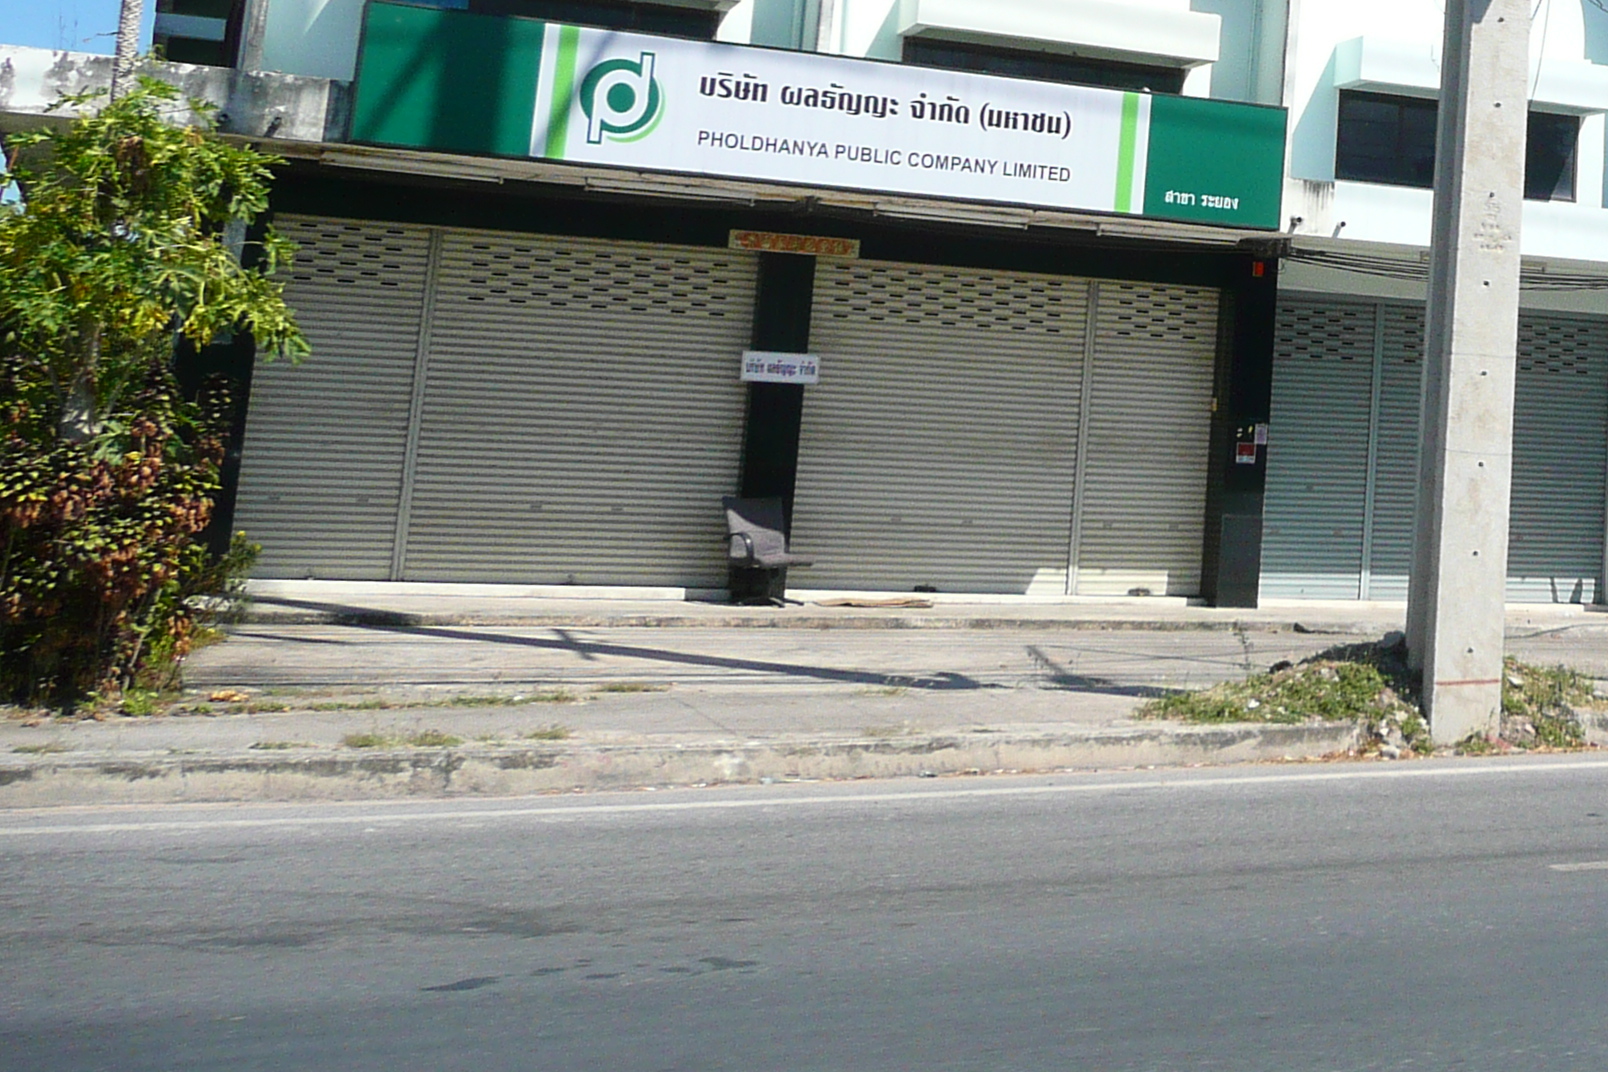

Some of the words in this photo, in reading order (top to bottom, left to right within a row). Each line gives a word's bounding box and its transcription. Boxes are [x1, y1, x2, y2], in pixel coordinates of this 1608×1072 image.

[699, 72, 768, 102] บริษัท
[781, 83, 899, 118] ผลธัญญะ
[910, 93, 970, 124] จำกัด
[980, 102, 1071, 140] (มหาชน)
[698, 130, 829, 158] PHOLDHANYA
[834, 144, 901, 165] PUBLIC
[908, 152, 998, 175] COMPANY
[1003, 161, 1071, 182] LIMITED
[1164, 190, 1195, 206] สาขา
[1200, 194, 1239, 210] ระยอง
